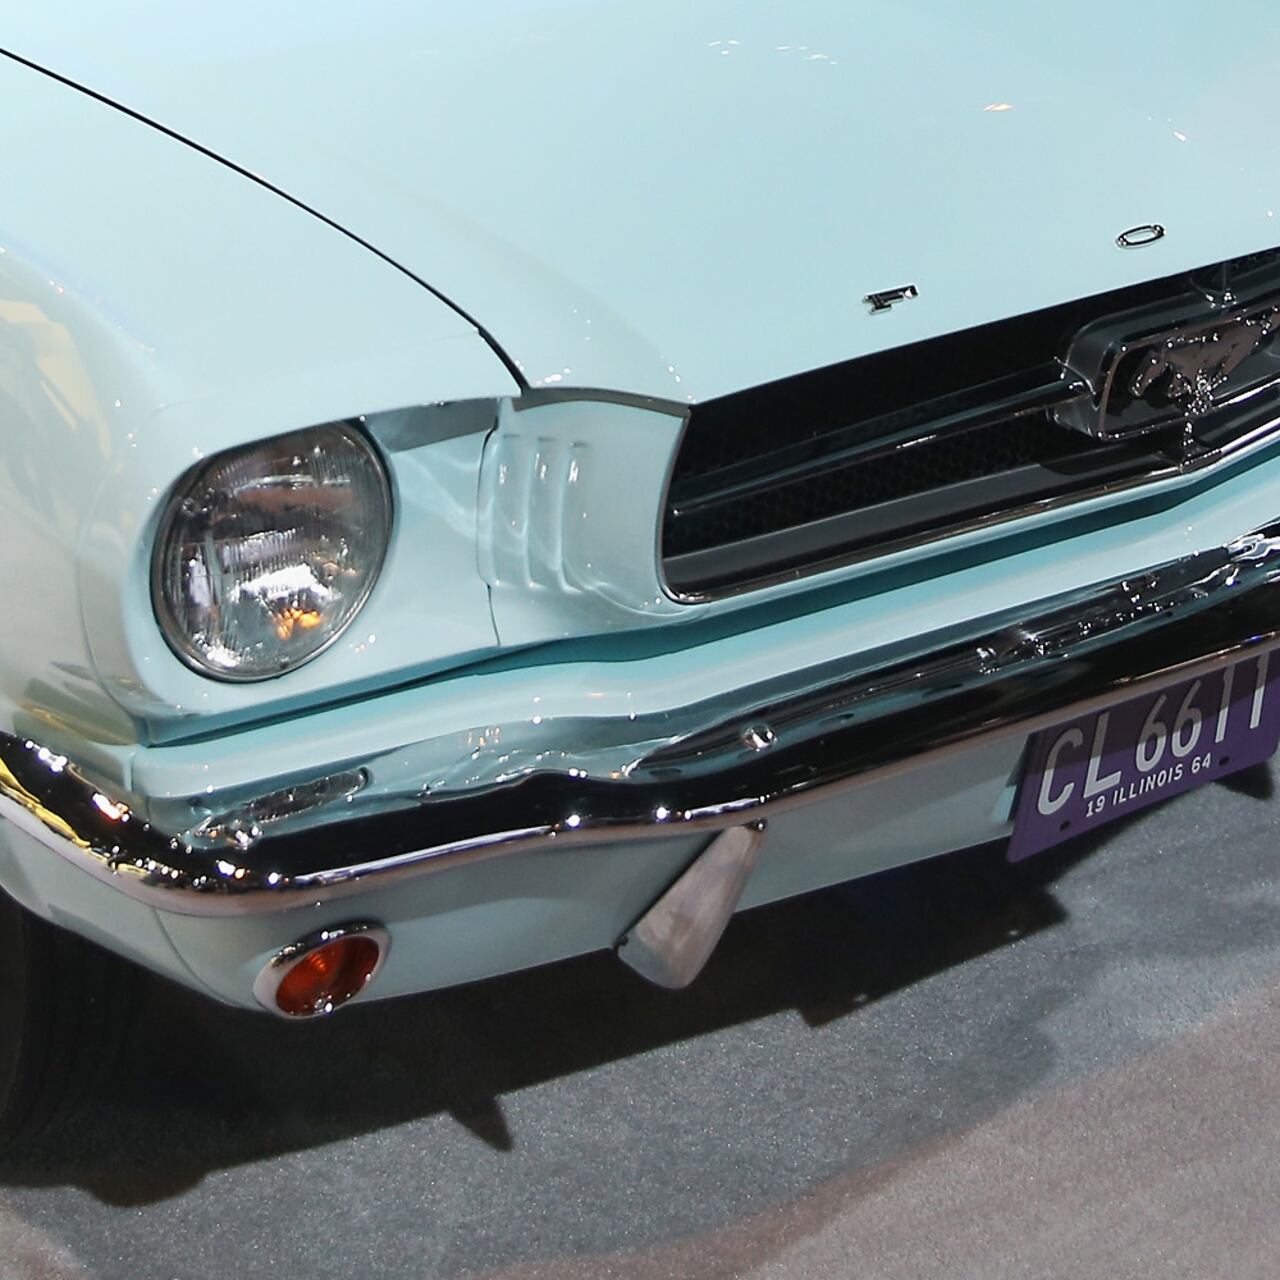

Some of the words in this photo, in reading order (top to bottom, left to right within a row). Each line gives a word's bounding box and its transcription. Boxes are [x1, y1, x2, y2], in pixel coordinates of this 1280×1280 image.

[1036, 711, 1122, 816] CL
[1085, 795, 1105, 818] 19
[1112, 764, 1183, 807] ILLINOIS
[1191, 752, 1212, 775] 64
